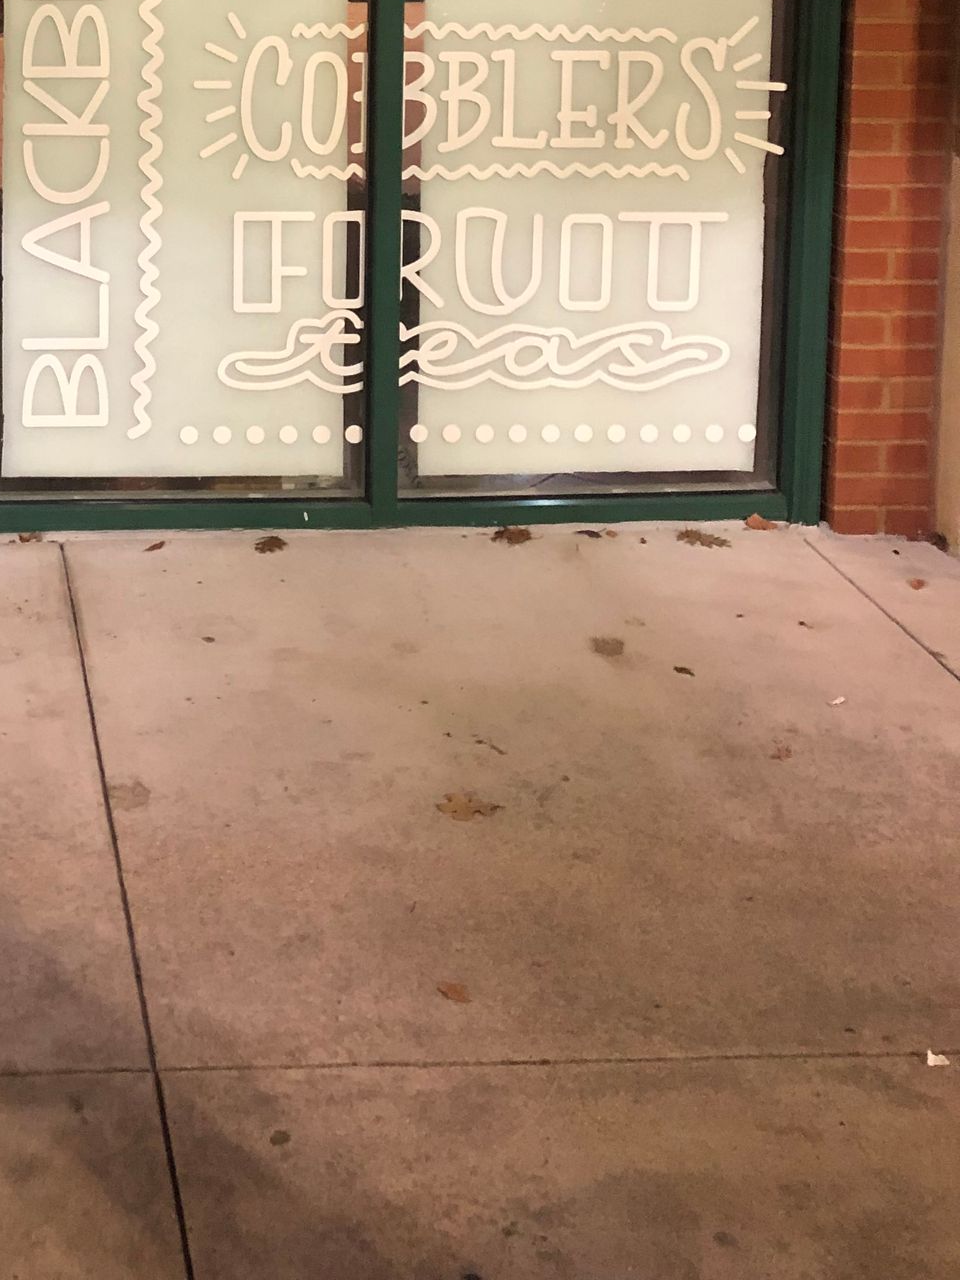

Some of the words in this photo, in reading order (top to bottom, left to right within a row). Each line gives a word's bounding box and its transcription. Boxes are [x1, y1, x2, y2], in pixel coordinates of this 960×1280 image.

[241, 33, 728, 161] COBBLERS
[233, 207, 729, 315] FRUIT
[236, 318, 708, 377] teas
